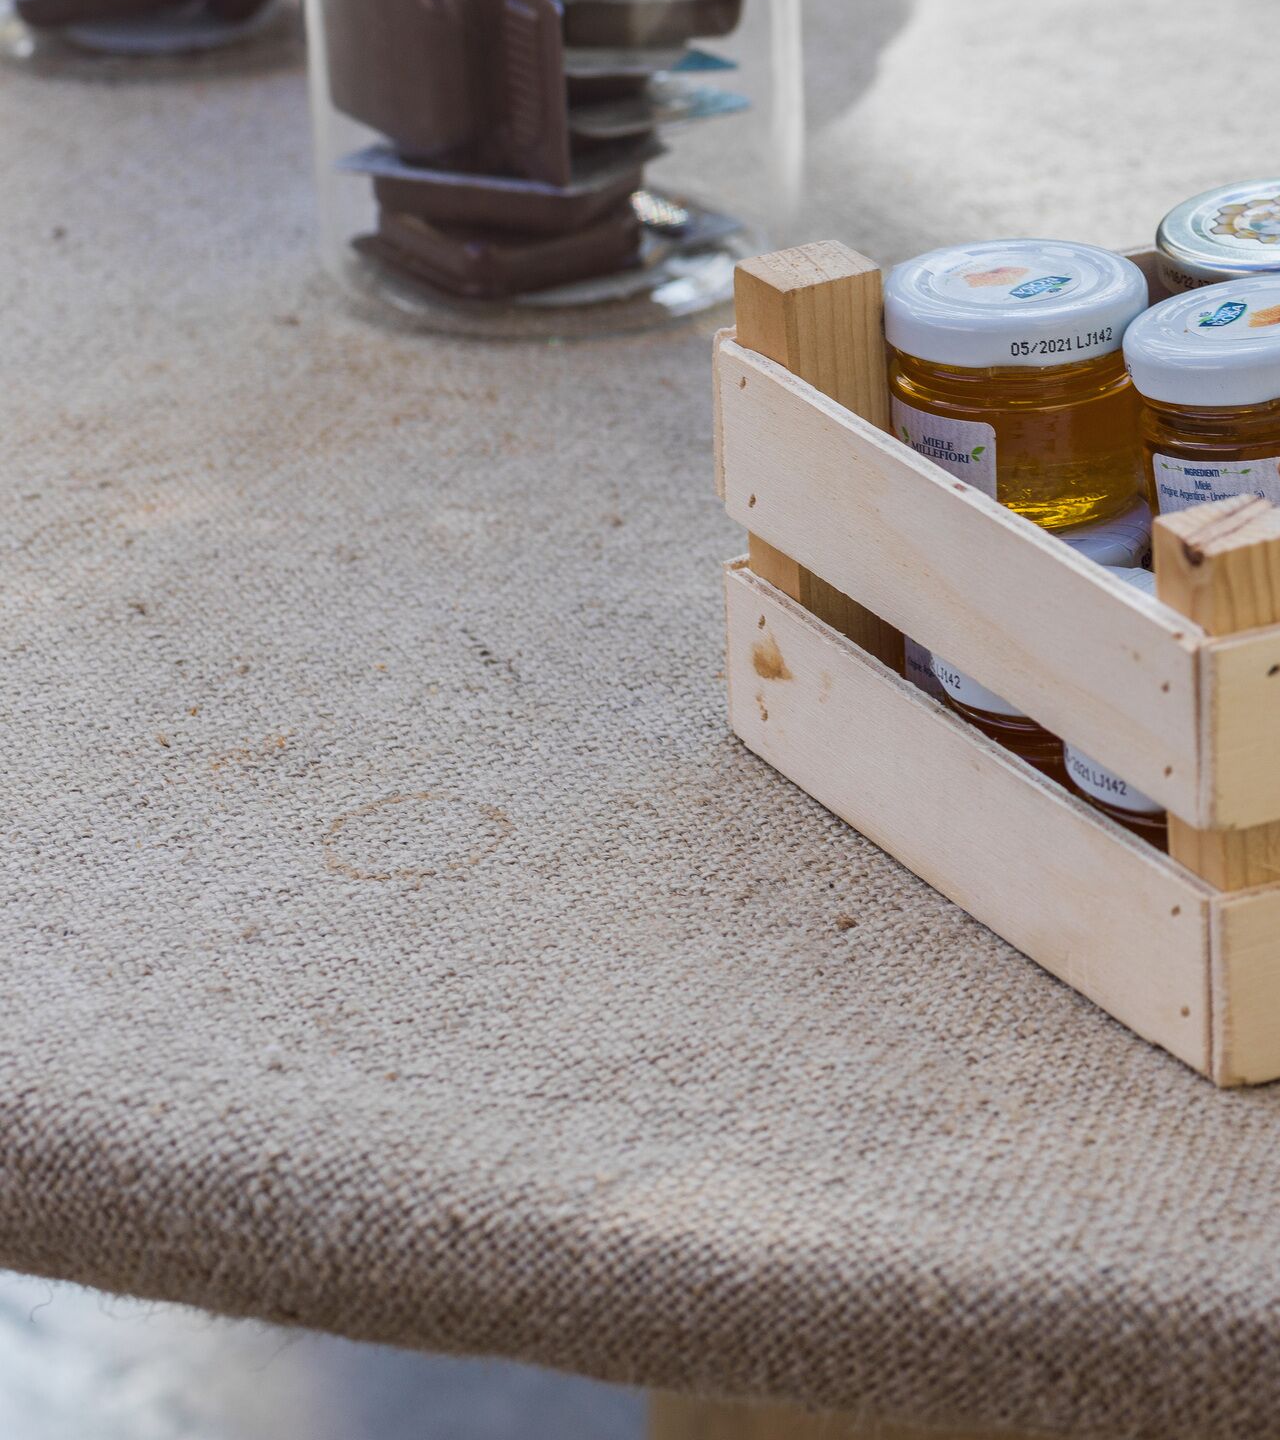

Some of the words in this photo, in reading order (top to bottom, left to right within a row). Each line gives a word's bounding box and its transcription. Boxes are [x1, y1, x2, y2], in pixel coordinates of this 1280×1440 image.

[1010, 338, 1072, 357] 05/2021
[1077, 327, 1113, 350] LJ142
[911, 440, 971, 464] MILLEFIORI
[922, 435, 955, 452] MIELE
[1183, 467, 1220, 478] INGREDIENTI
[1194, 480, 1212, 491] Miele
[1092, 771, 1128, 796] LJ142
